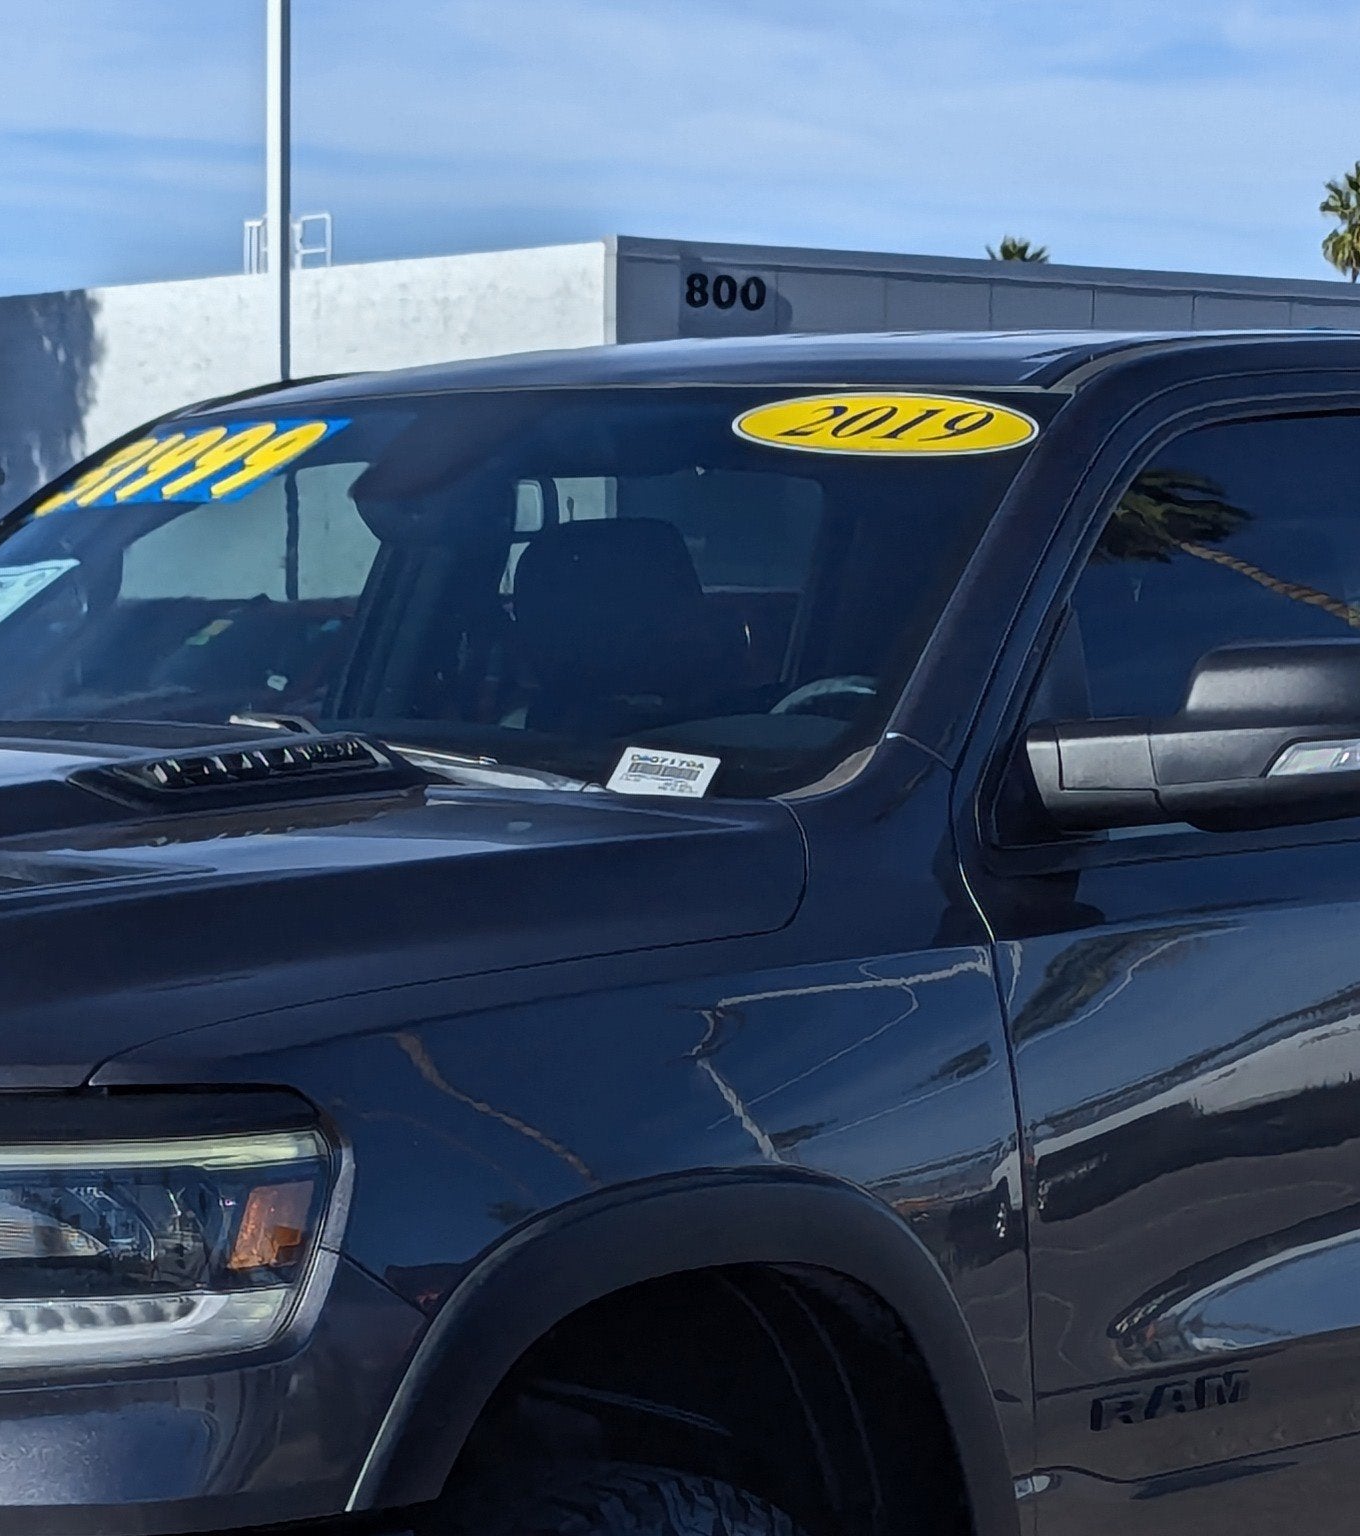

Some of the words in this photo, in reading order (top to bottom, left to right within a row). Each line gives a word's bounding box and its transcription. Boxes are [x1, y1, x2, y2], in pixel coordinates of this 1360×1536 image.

[686, 273, 766, 311] 800
[774, 406, 995, 442] 2019
[1090, 1369, 1251, 1431] RAM
